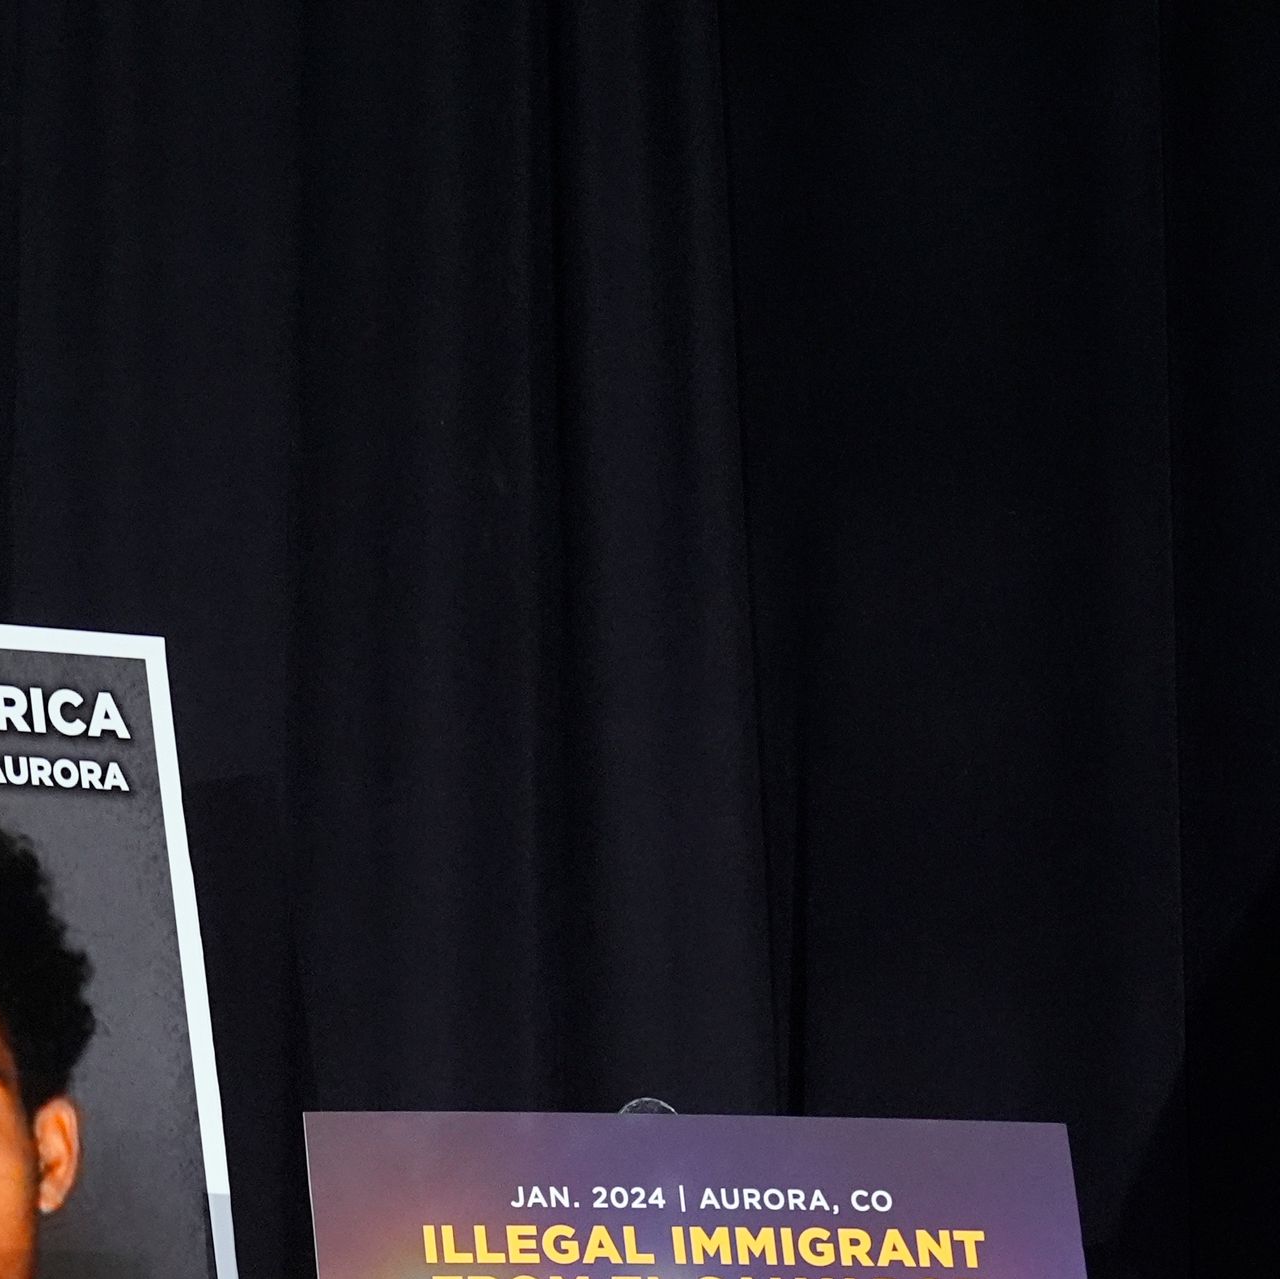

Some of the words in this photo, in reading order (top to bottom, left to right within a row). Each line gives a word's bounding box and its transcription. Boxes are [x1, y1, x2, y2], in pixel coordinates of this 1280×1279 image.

[510, 1185, 580, 1208] JAN.
[592, 1186, 666, 1209] 2024
[699, 1187, 839, 1215] AURORA,
[850, 1189, 893, 1212] CO
[422, 1224, 656, 1265] ILLEGAL
[671, 1226, 985, 1269] IMMIGRANT
